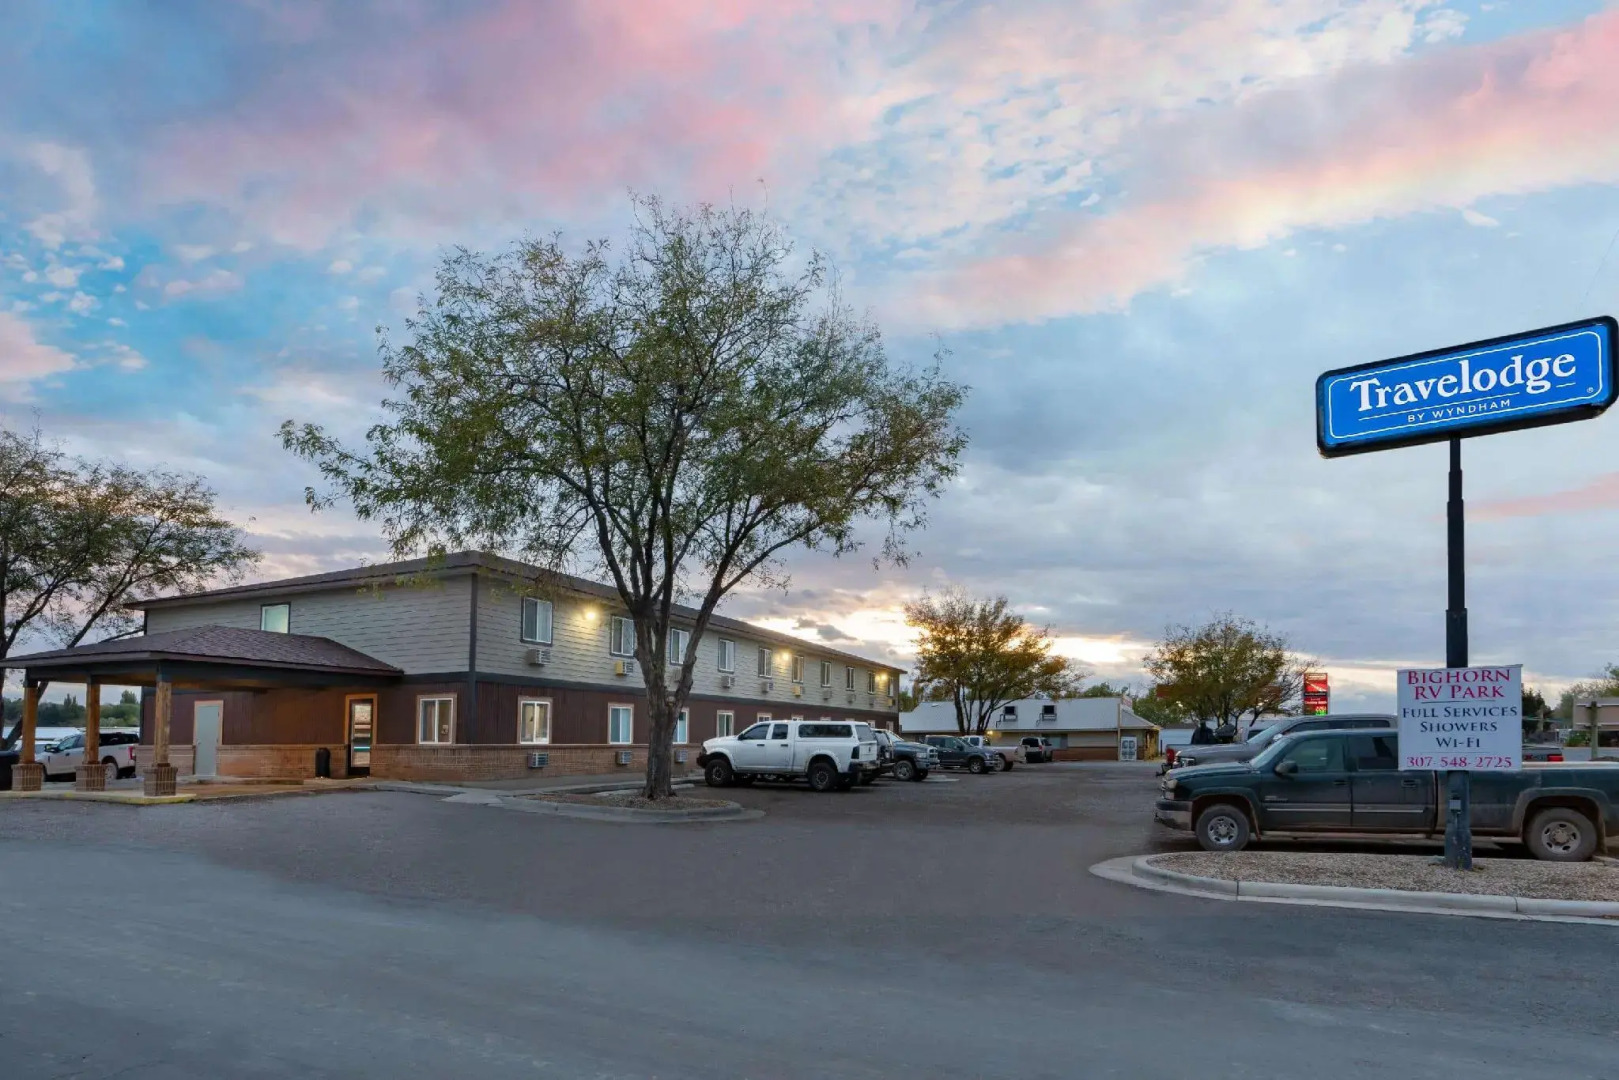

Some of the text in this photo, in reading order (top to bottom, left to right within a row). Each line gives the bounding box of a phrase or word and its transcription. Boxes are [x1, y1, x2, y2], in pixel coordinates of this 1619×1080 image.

[1350, 353, 1577, 412] Travelodge
[1407, 399, 1511, 423] BY WYNDHAM
[1408, 669, 1511, 685] BIGHORN
[1414, 685, 1505, 700] RV PARK
[1403, 706, 1518, 718] FULL SERVICES
[1420, 721, 1498, 733] SHOWERS
[1436, 737, 1481, 748] WI-FI
[1406, 756, 1512, 768] 307-548-2725
